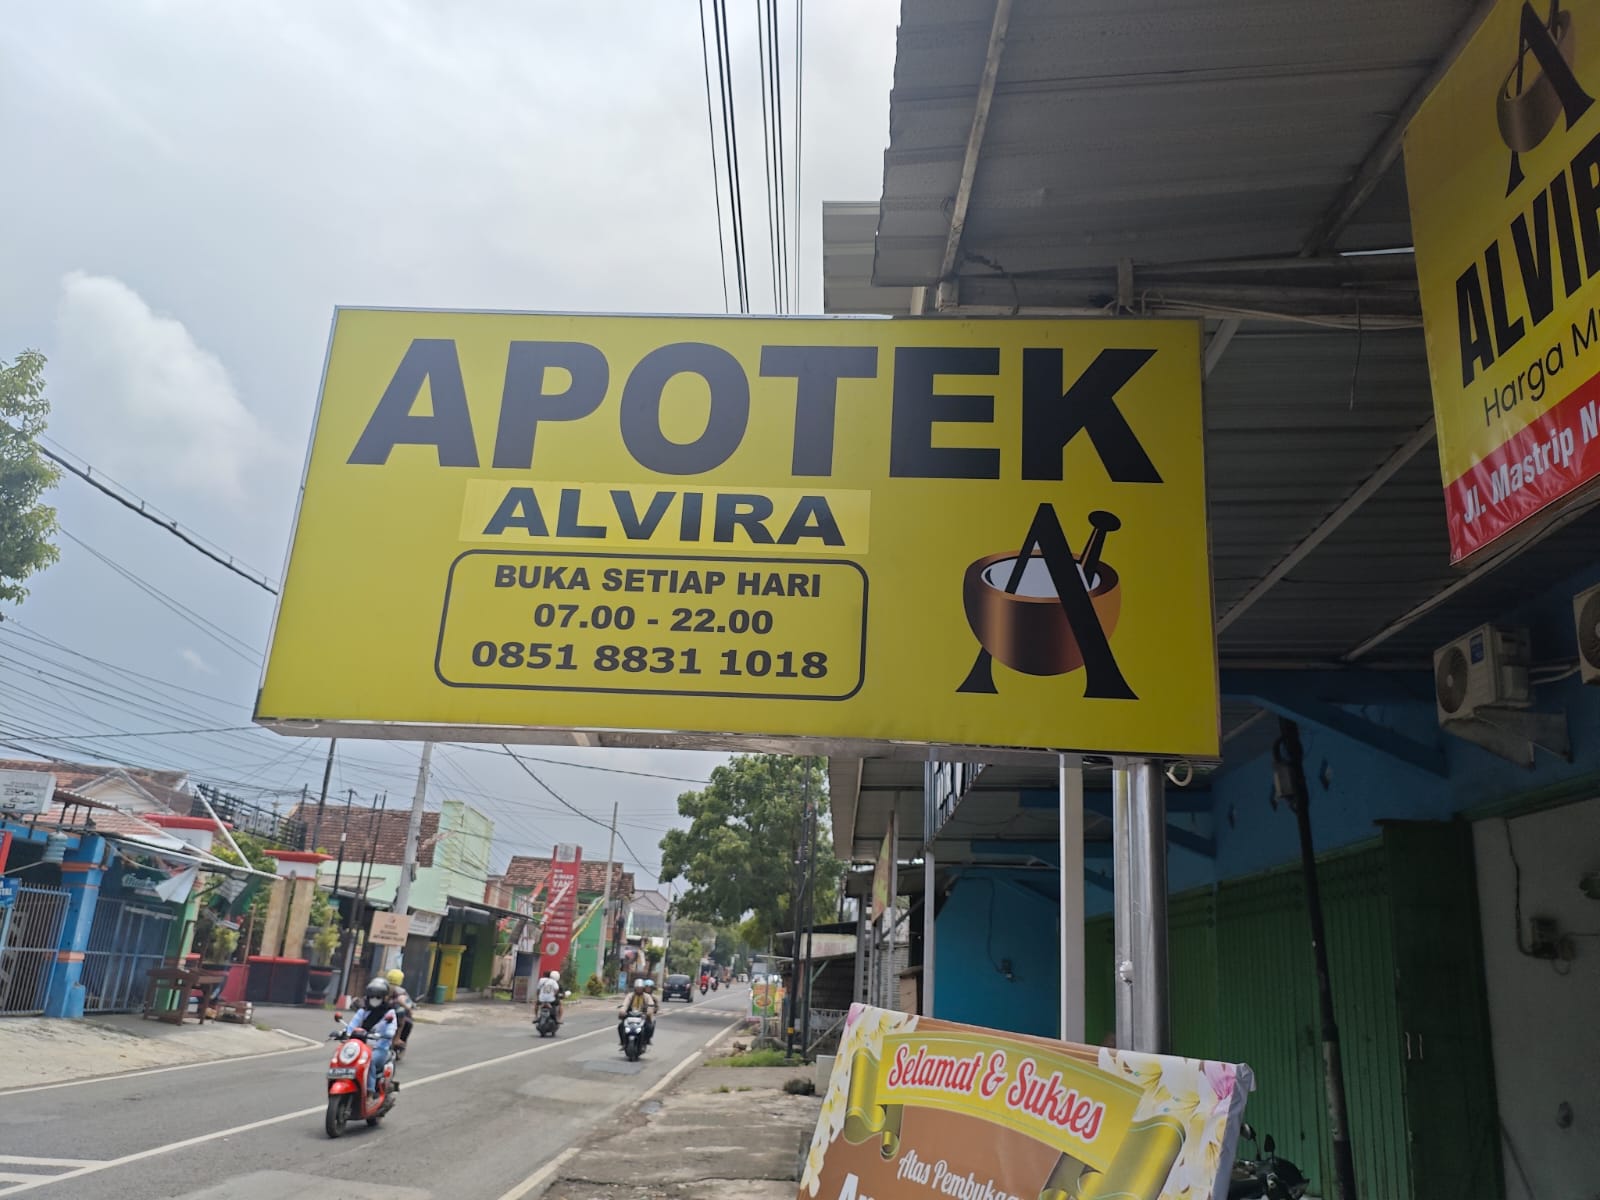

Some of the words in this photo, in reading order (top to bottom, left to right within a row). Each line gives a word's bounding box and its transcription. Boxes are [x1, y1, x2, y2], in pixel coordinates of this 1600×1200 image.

[346, 337, 1164, 484] APOTEK
[1483, 342, 1564, 427] Harga
[1463, 487, 1487, 524] Jl.
[1491, 424, 1575, 505] Mastrip
[483, 487, 846, 547] ALVIRA
[494, 564, 591, 592] BUKA
[601, 568, 726, 597] SETIAP
[737, 571, 821, 598] HARI
[534, 603, 636, 631] 07.00
[670, 607, 774, 635] 22.00
[471, 640, 578, 671] 0851
[593, 645, 703, 676] 8831
[719, 649, 828, 679] 1018
[887, 1043, 981, 1094] Selamat
[980, 1049, 1007, 1098] &
[1007, 1060, 1107, 1140] Sukses
[896, 1149, 931, 1185] Atas
